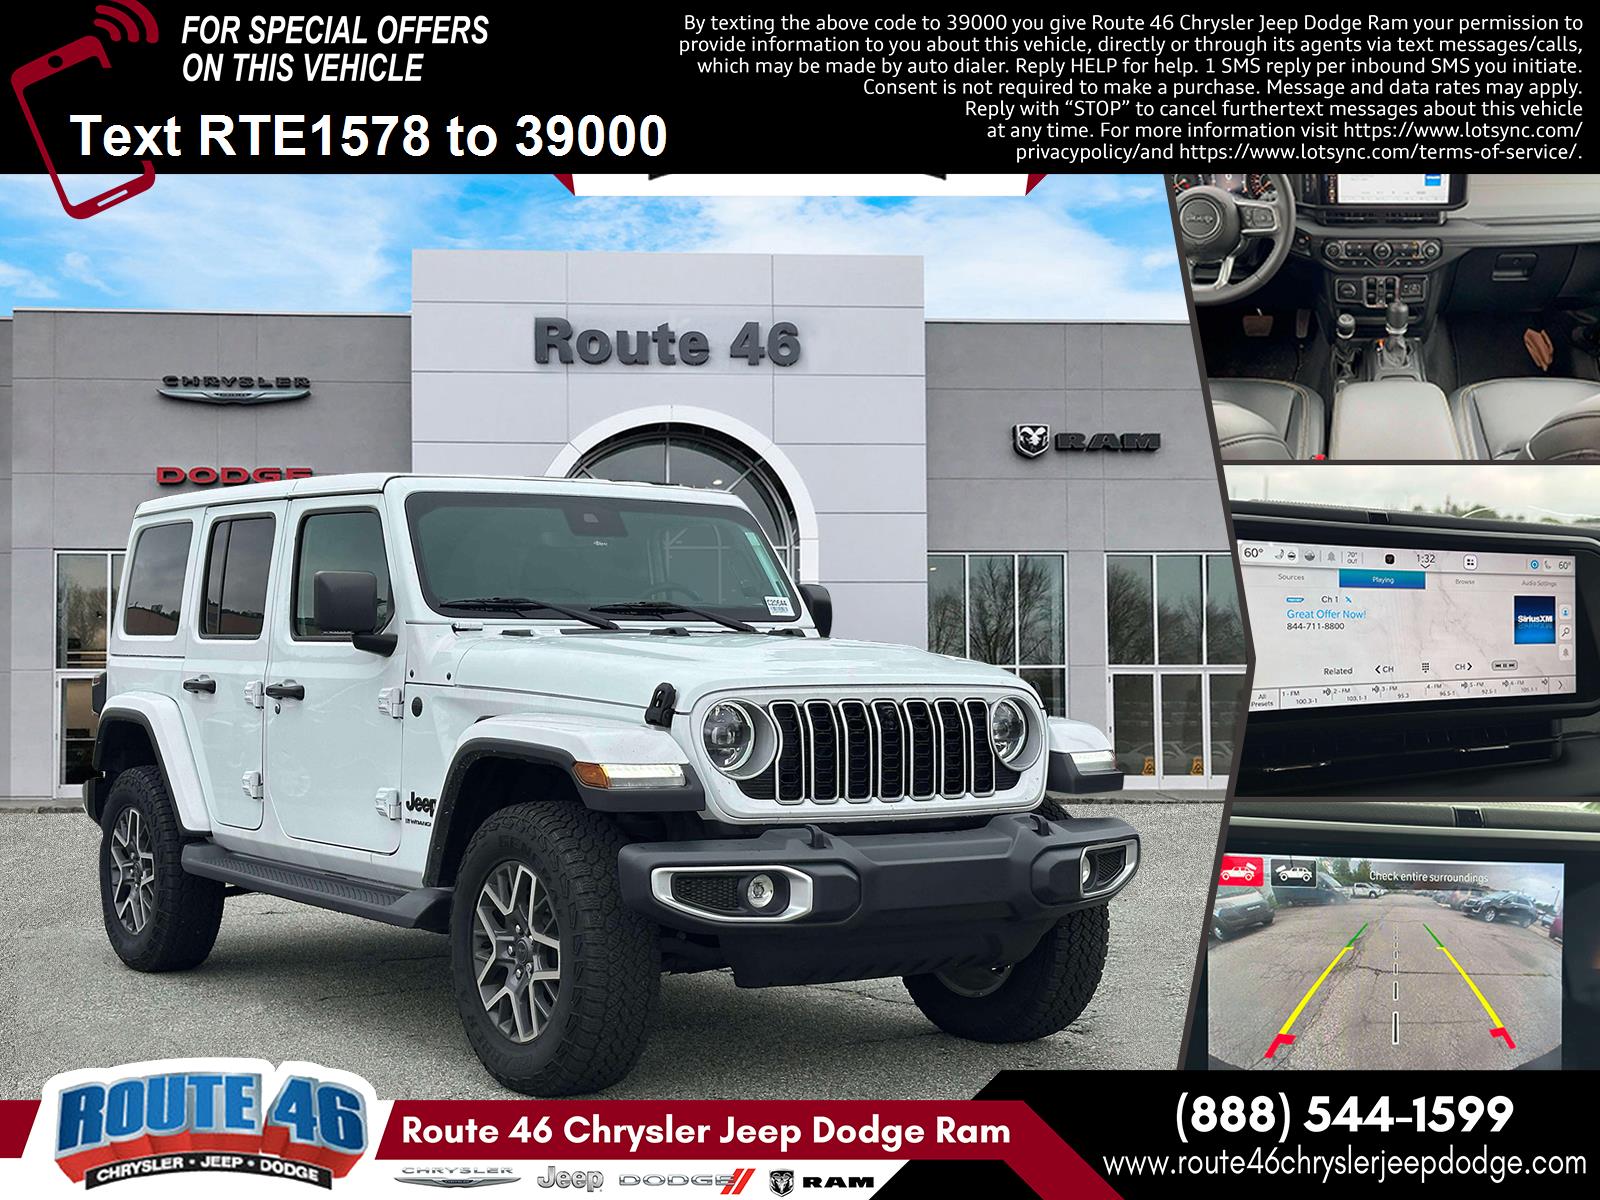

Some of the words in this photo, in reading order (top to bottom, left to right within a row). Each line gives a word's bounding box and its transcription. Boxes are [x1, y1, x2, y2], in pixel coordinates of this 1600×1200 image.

[534, 317, 710, 366] Route
[729, 321, 801, 366] 46
[162, 375, 311, 389] CHRYSLER
[1055, 432, 1162, 452] RAM
[1416, 554, 1436, 563] 1:32
[1278, 573, 1304, 581] Sources
[1372, 576, 1395, 585] Playing
[1286, 609, 1314, 620] Great
[1316, 609, 1341, 620] Offer
[1342, 611, 1366, 620] Now!
[1518, 615, 1553, 623] SiriusXM
[1286, 622, 1344, 630] 844-711-8800
[1369, 871, 1399, 881] Check
[1401, 872, 1428, 882] entire
[1429, 872, 1489, 884] surroundings
